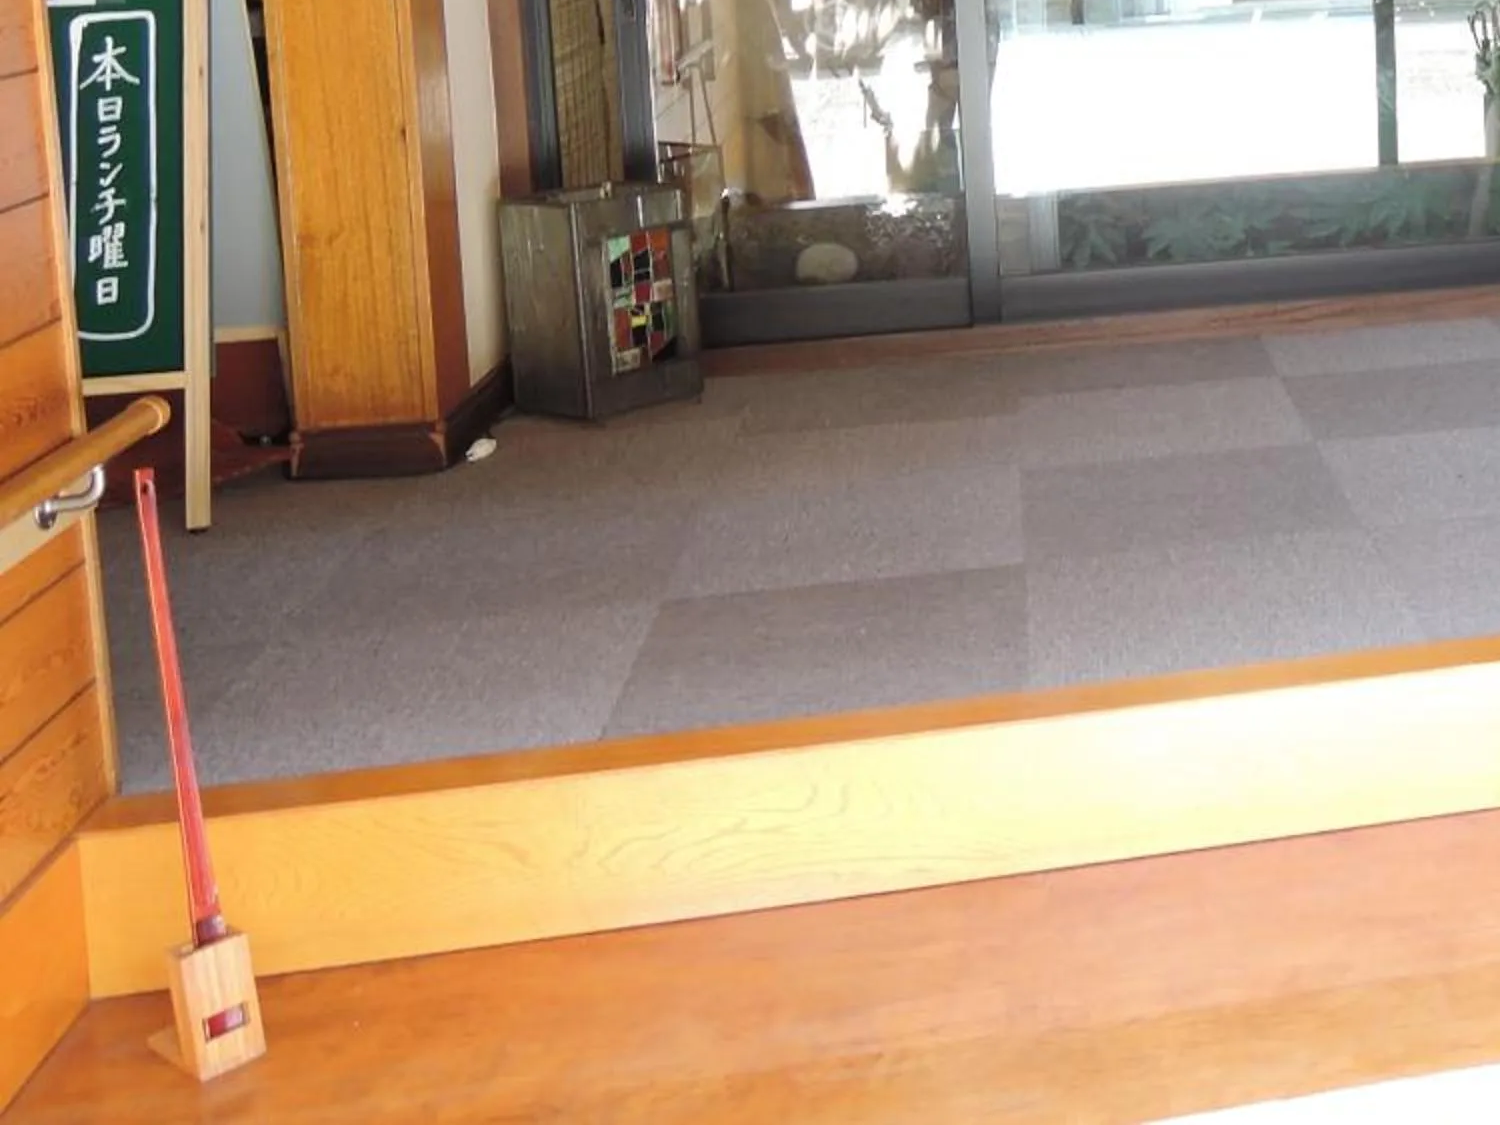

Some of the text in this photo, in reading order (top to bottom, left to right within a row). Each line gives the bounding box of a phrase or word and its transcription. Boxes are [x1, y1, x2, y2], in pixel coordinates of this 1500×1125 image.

[79, 36, 141, 305] 本日ランチ曜日
